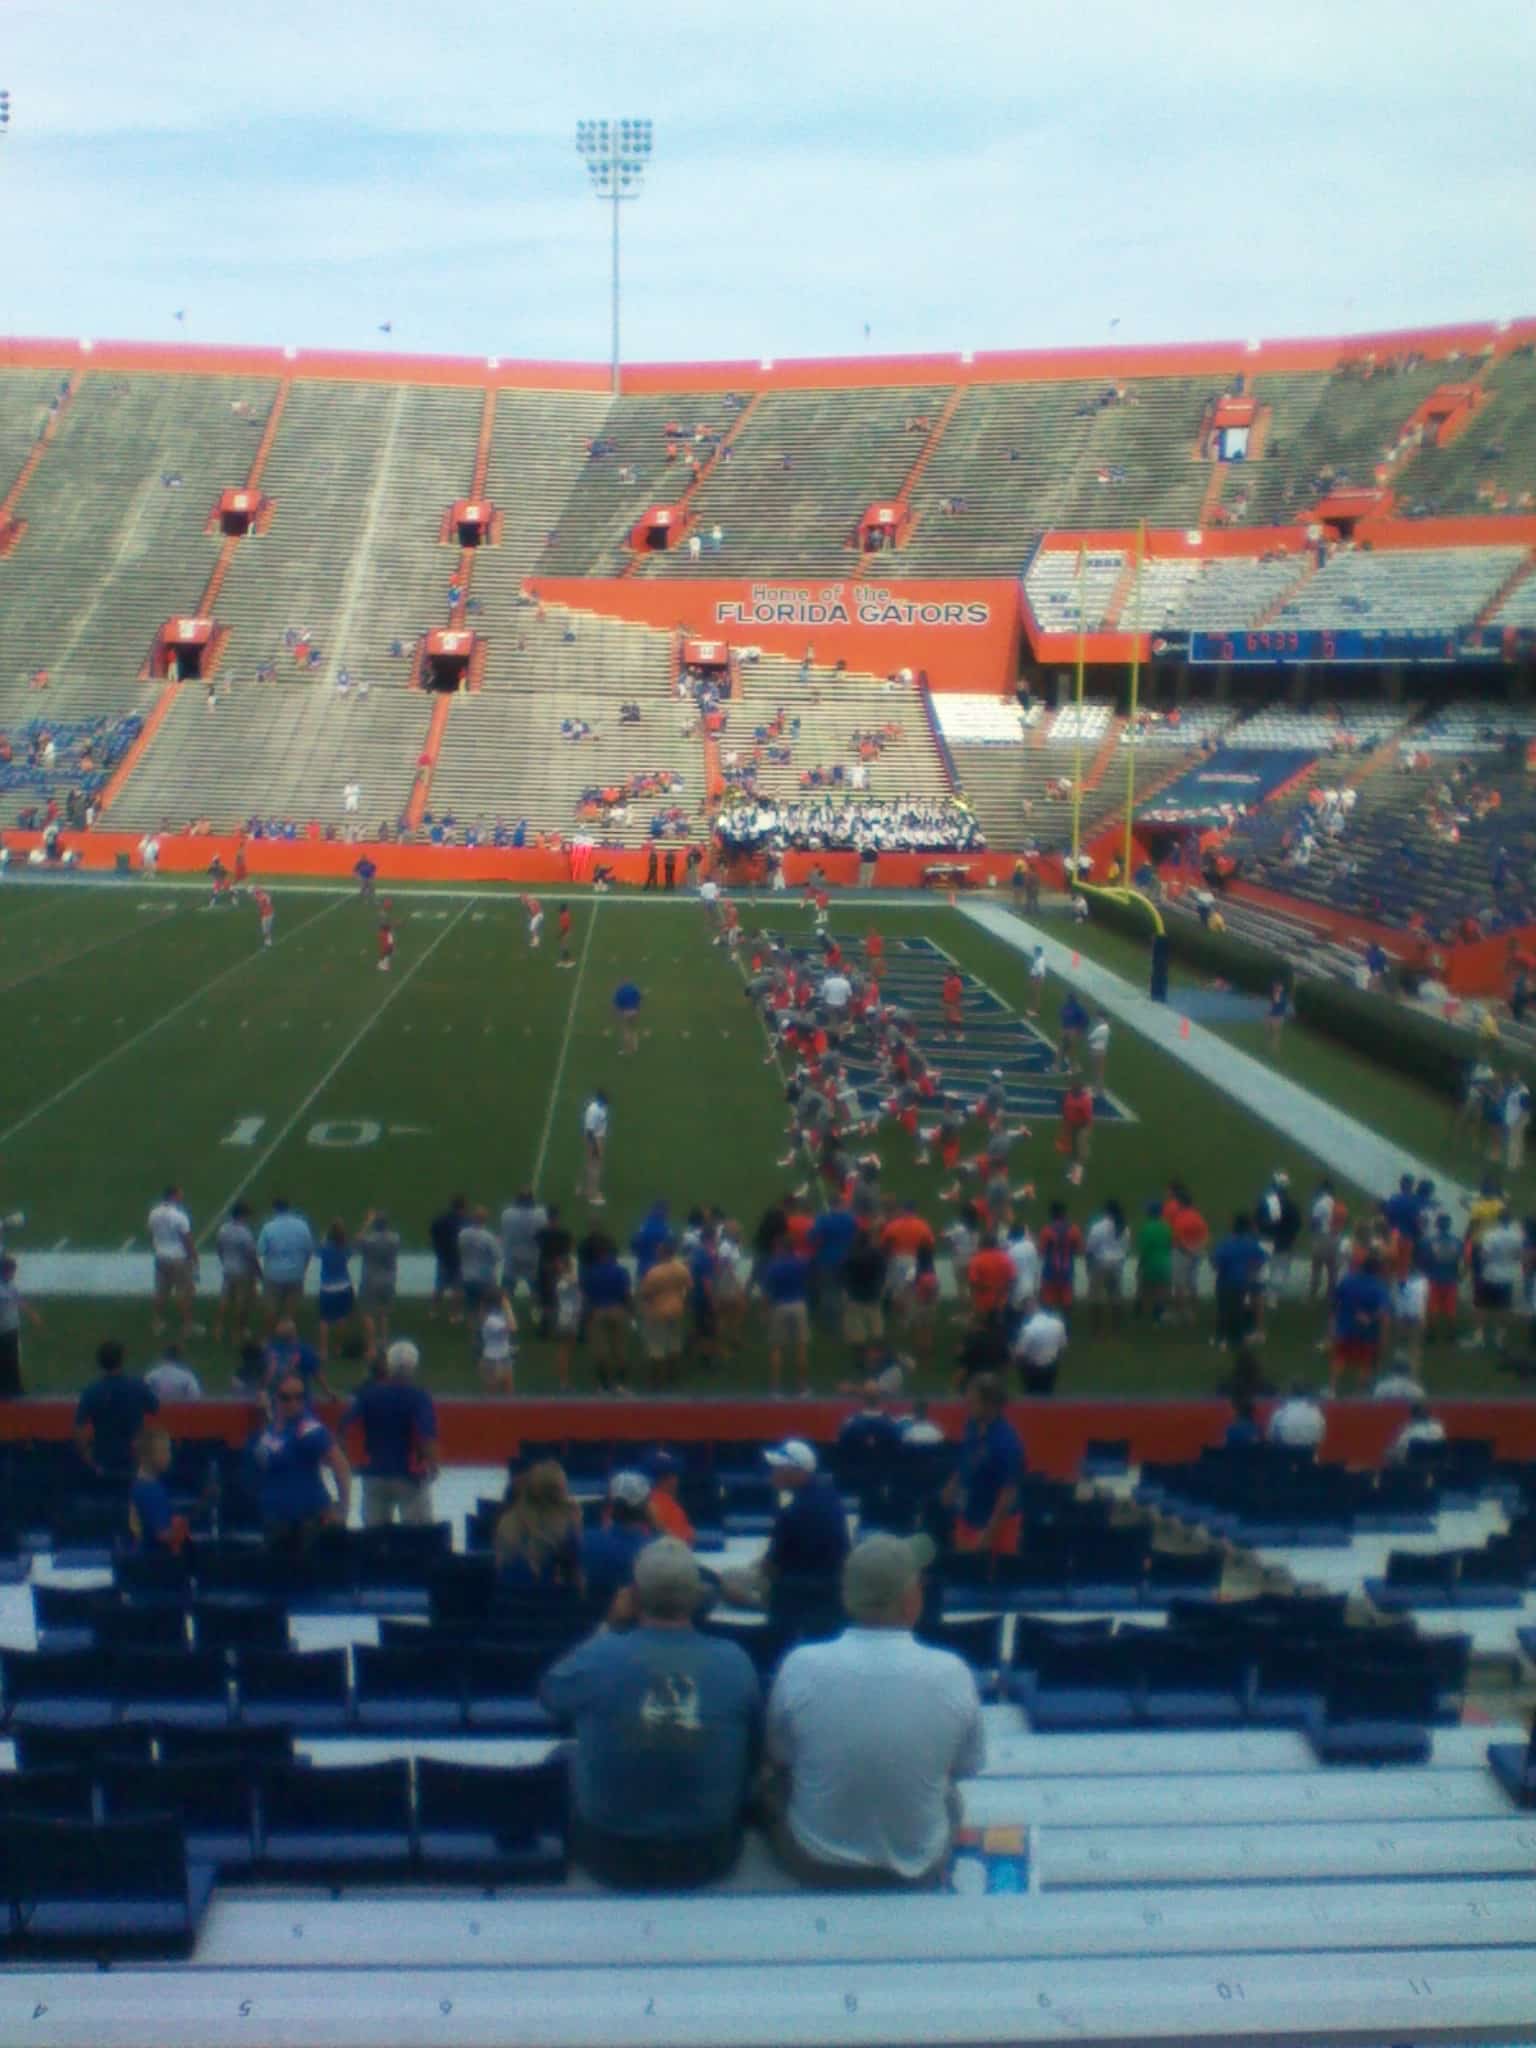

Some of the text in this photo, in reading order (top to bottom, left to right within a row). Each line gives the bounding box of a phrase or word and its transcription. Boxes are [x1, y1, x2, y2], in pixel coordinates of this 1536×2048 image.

[752, 584, 890, 602] Home of the
[715, 602, 989, 624] FLORIDA GATORS
[220, 1117, 381, 1147] 10
[238, 2000, 252, 2017] 5
[1217, 1981, 1245, 2001] 10
[1407, 1977, 1432, 1997] 11
